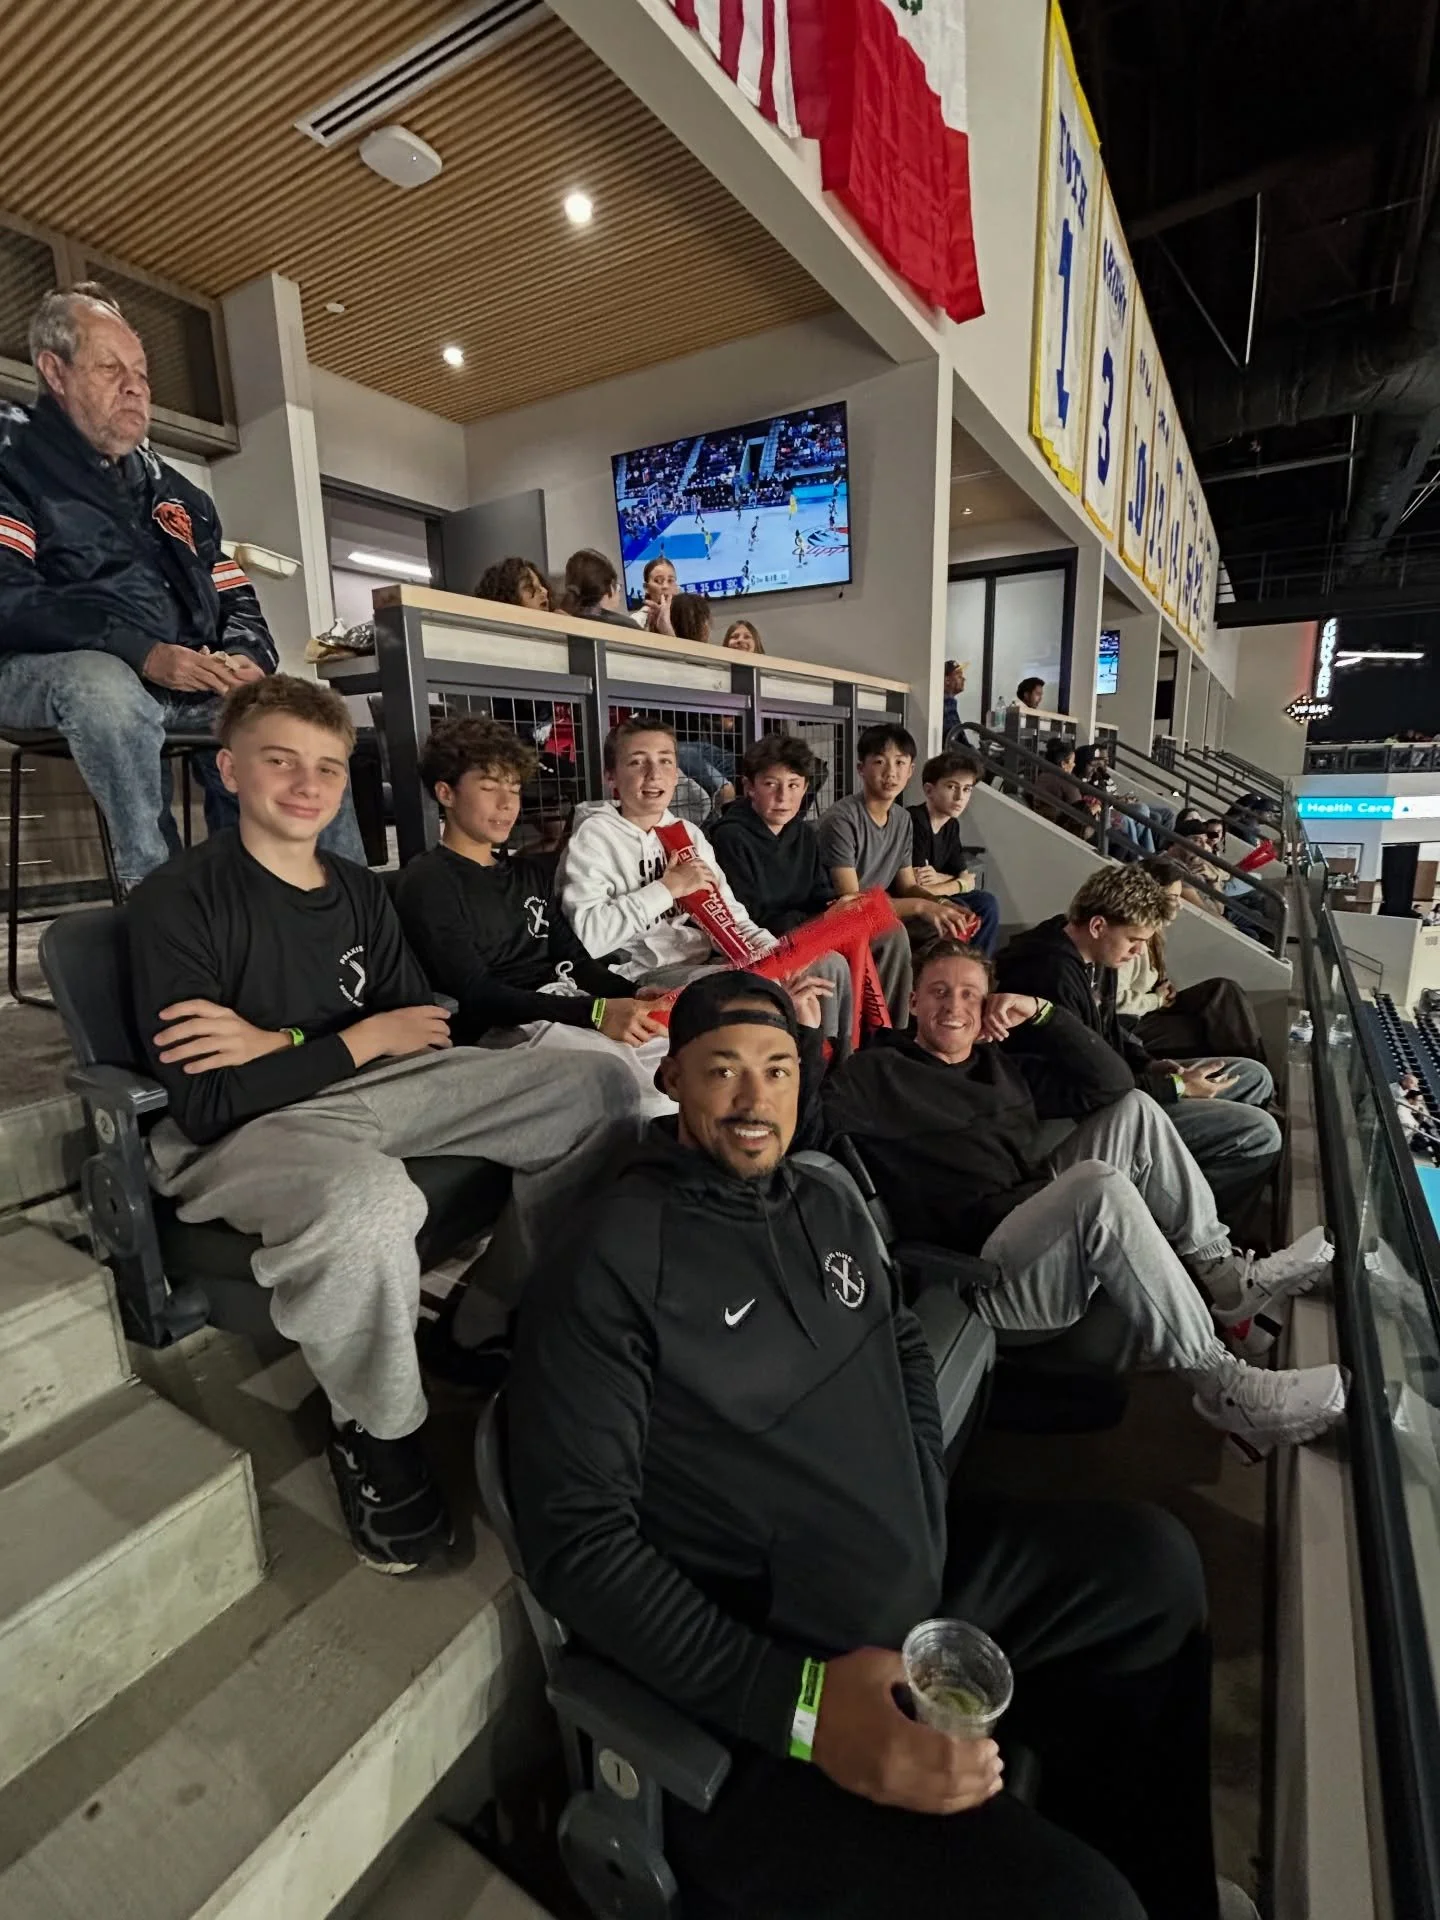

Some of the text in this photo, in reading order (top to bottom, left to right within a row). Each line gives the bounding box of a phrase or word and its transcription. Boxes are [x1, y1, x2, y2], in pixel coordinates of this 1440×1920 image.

[1056, 218, 1075, 430] 1
[1097, 347, 1115, 486] 3
[1307, 803, 1353, 813] Health
